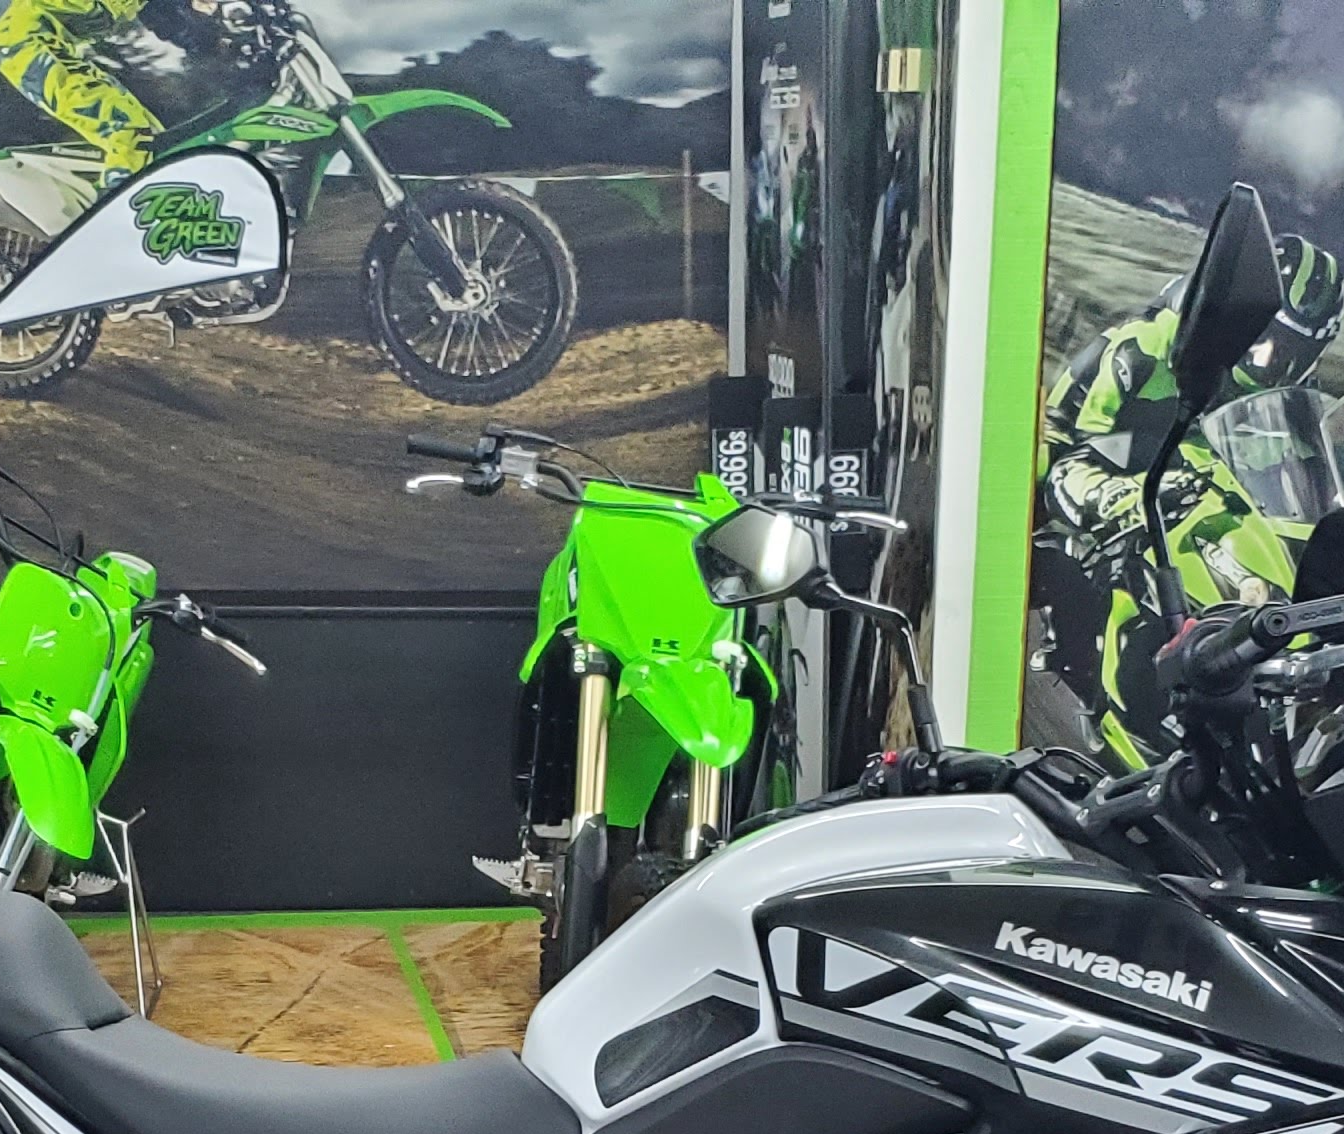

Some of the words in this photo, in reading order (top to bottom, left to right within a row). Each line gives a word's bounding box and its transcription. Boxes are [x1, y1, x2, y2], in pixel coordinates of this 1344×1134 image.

[130, 183, 222, 226] TEAM
[144, 217, 243, 263] GREEN
[994, 921, 1214, 1013] Kawasaki
